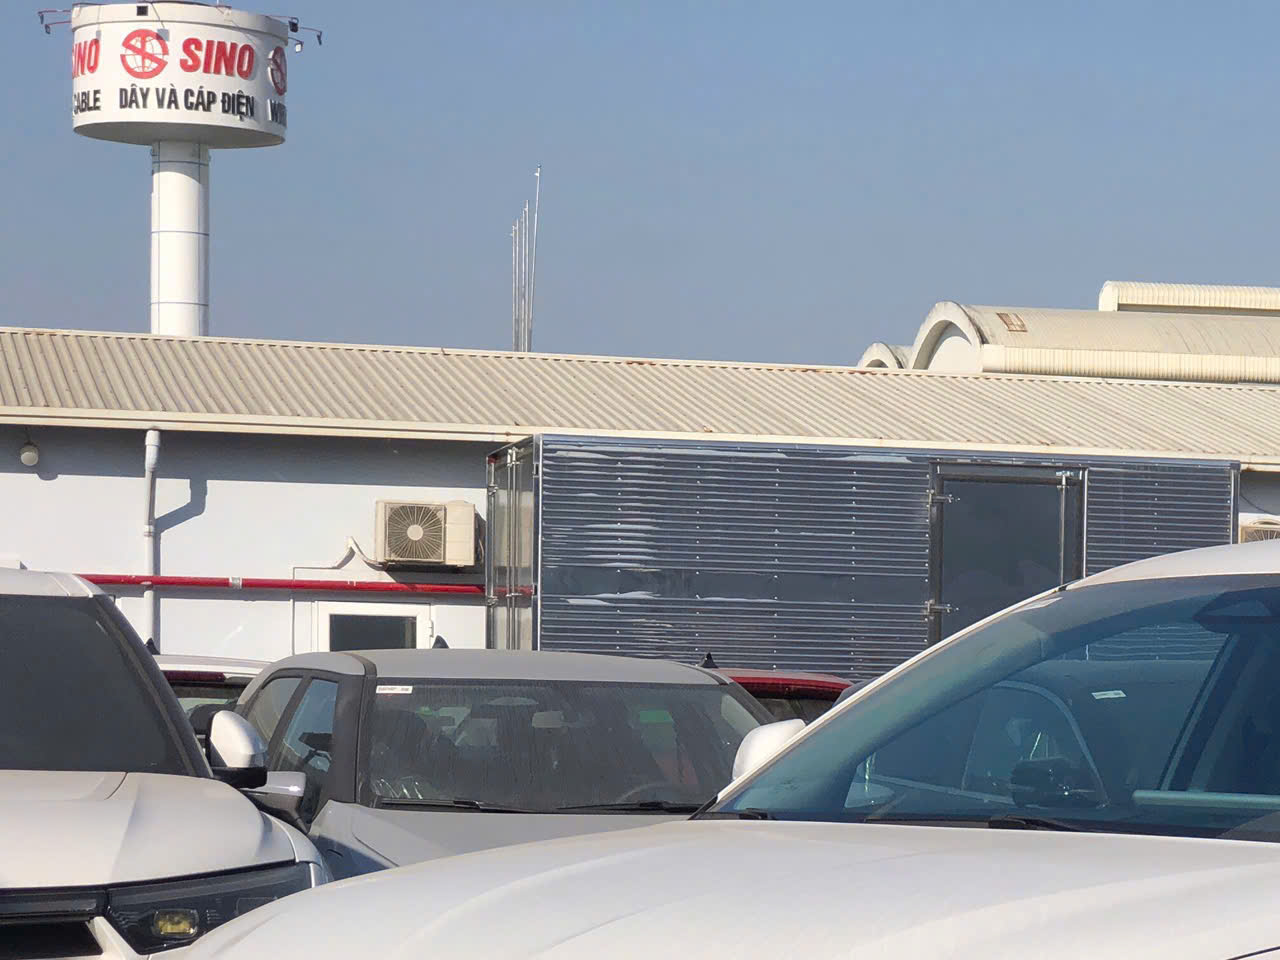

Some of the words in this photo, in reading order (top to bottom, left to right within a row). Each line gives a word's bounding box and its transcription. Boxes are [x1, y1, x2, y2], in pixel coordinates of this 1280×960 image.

[180, 38, 255, 80] SINO
[119, 83, 150, 109] DÂY
[155, 83, 180, 109] VÀ
[184, 86, 218, 112] CÁP
[221, 90, 255, 121] ĐIỆN
